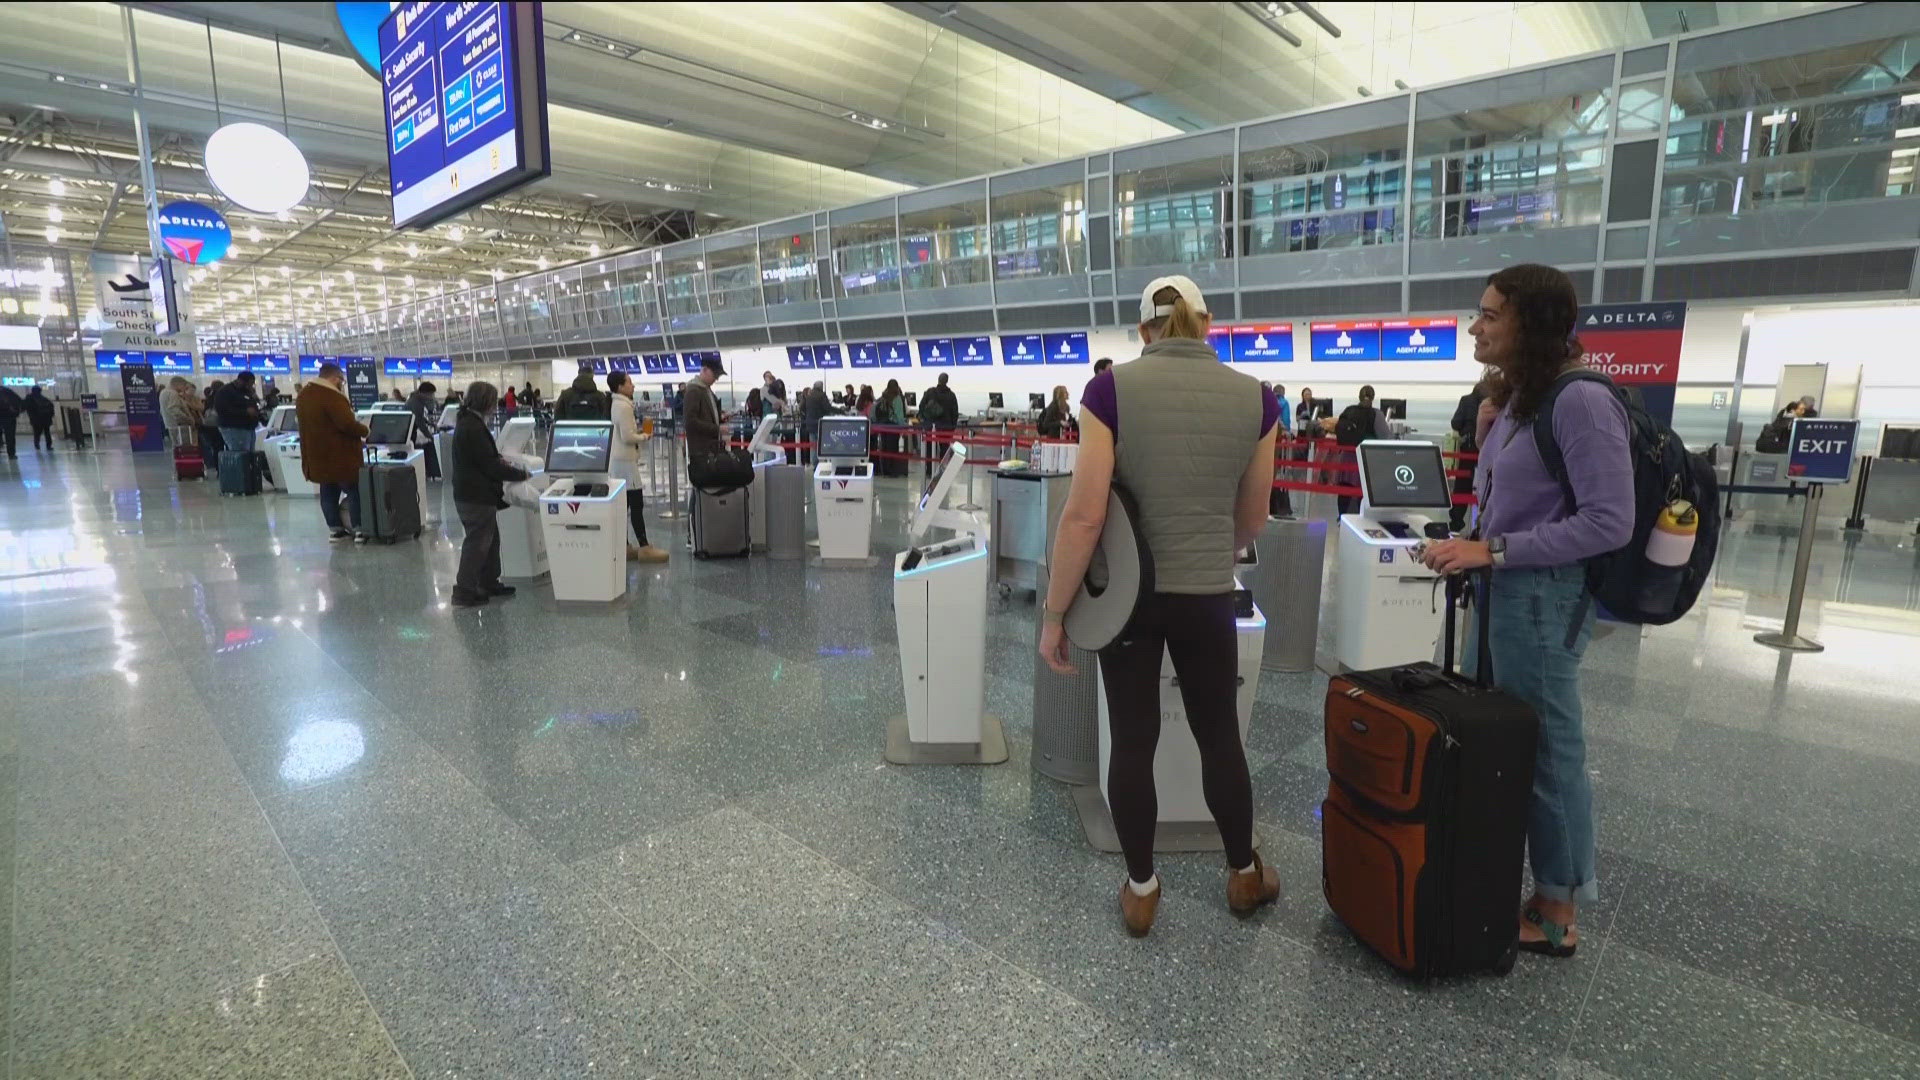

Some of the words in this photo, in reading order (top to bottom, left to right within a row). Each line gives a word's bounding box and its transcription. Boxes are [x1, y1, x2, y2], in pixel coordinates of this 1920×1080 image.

[172, 216, 214, 228] DELTA
[103, 308, 138, 318] South
[142, 310, 188, 322] Sety
[1603, 312, 1657, 324] DELTA
[125, 336, 140, 345] All
[145, 336, 177, 347] Gates
[1580, 352, 1616, 364] SKY
[1584, 363, 1665, 375] RIORITY
[3, 377, 35, 386] KCM
[829, 430, 850, 438] CHECK
[1799, 439, 1847, 454] EXIT
